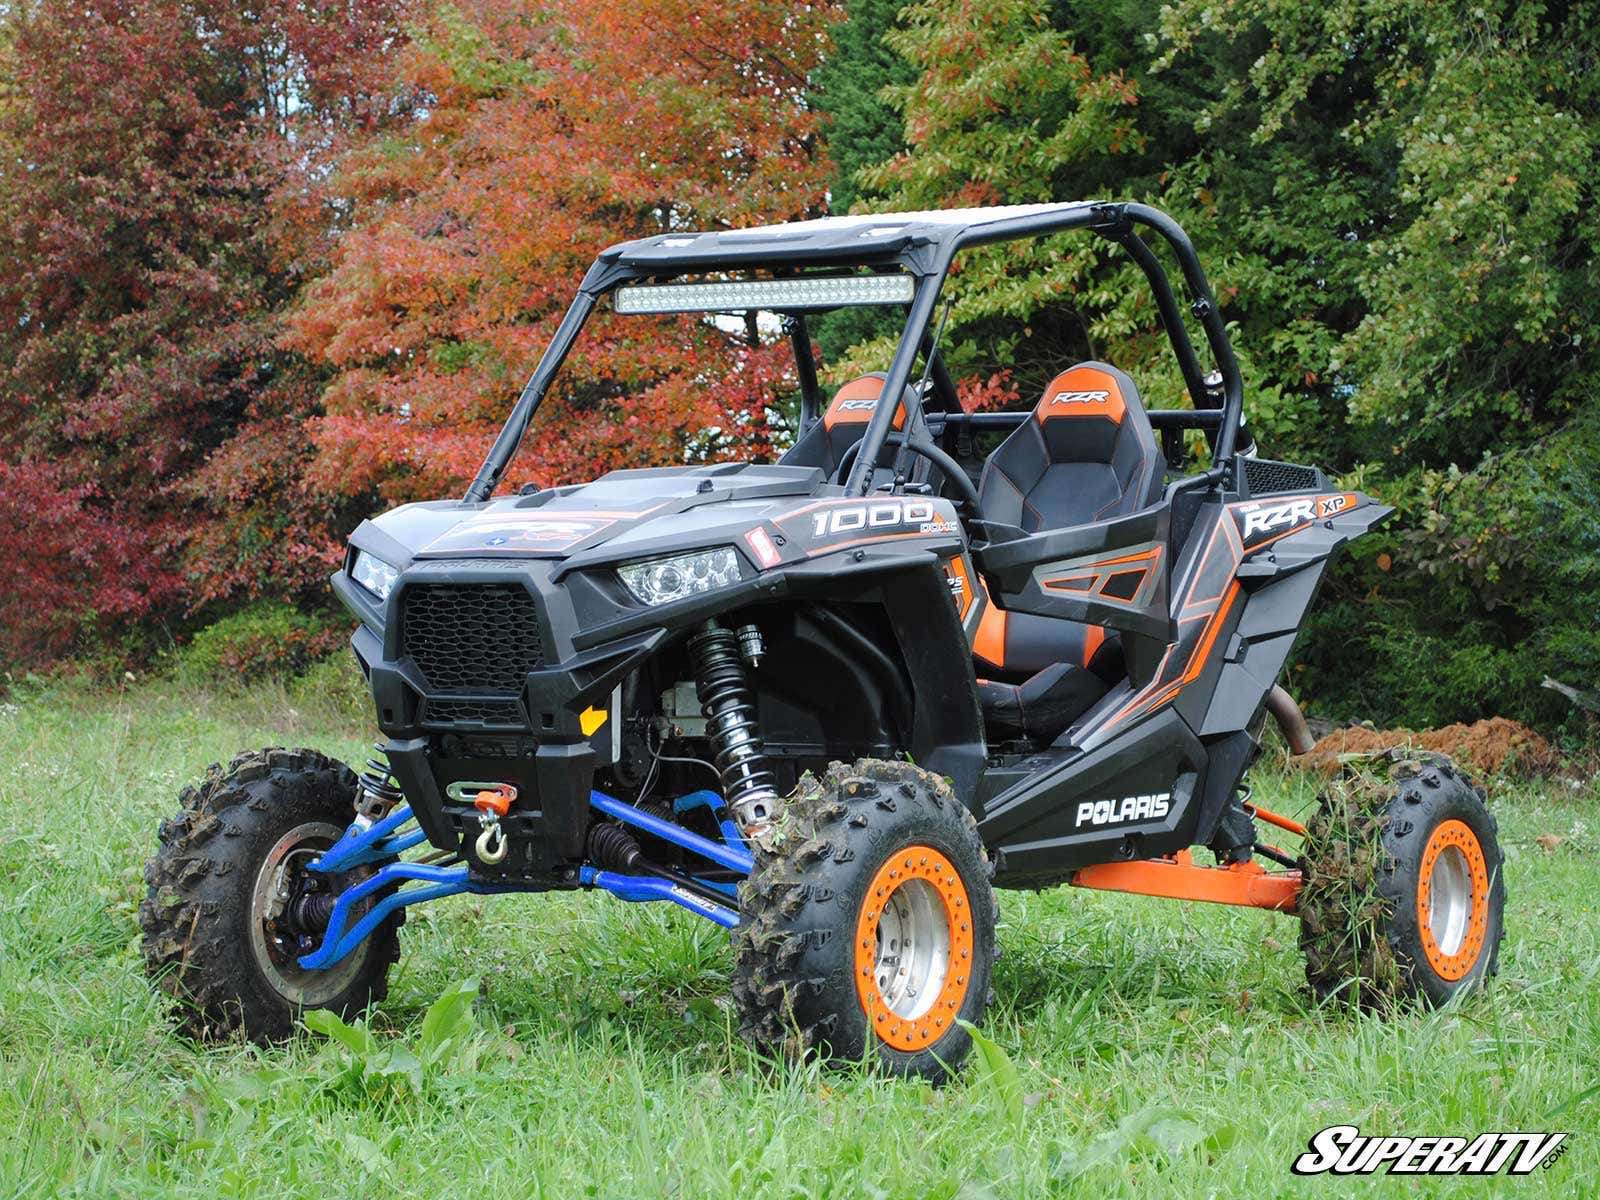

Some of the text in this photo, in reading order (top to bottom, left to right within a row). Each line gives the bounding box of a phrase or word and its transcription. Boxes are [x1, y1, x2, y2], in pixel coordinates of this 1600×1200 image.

[1051, 391, 1110, 405] RZR
[812, 503, 934, 538] 1000
[1244, 499, 1317, 540] RZR
[1321, 497, 1345, 515] XP
[1075, 793, 1170, 827] POLARIS
